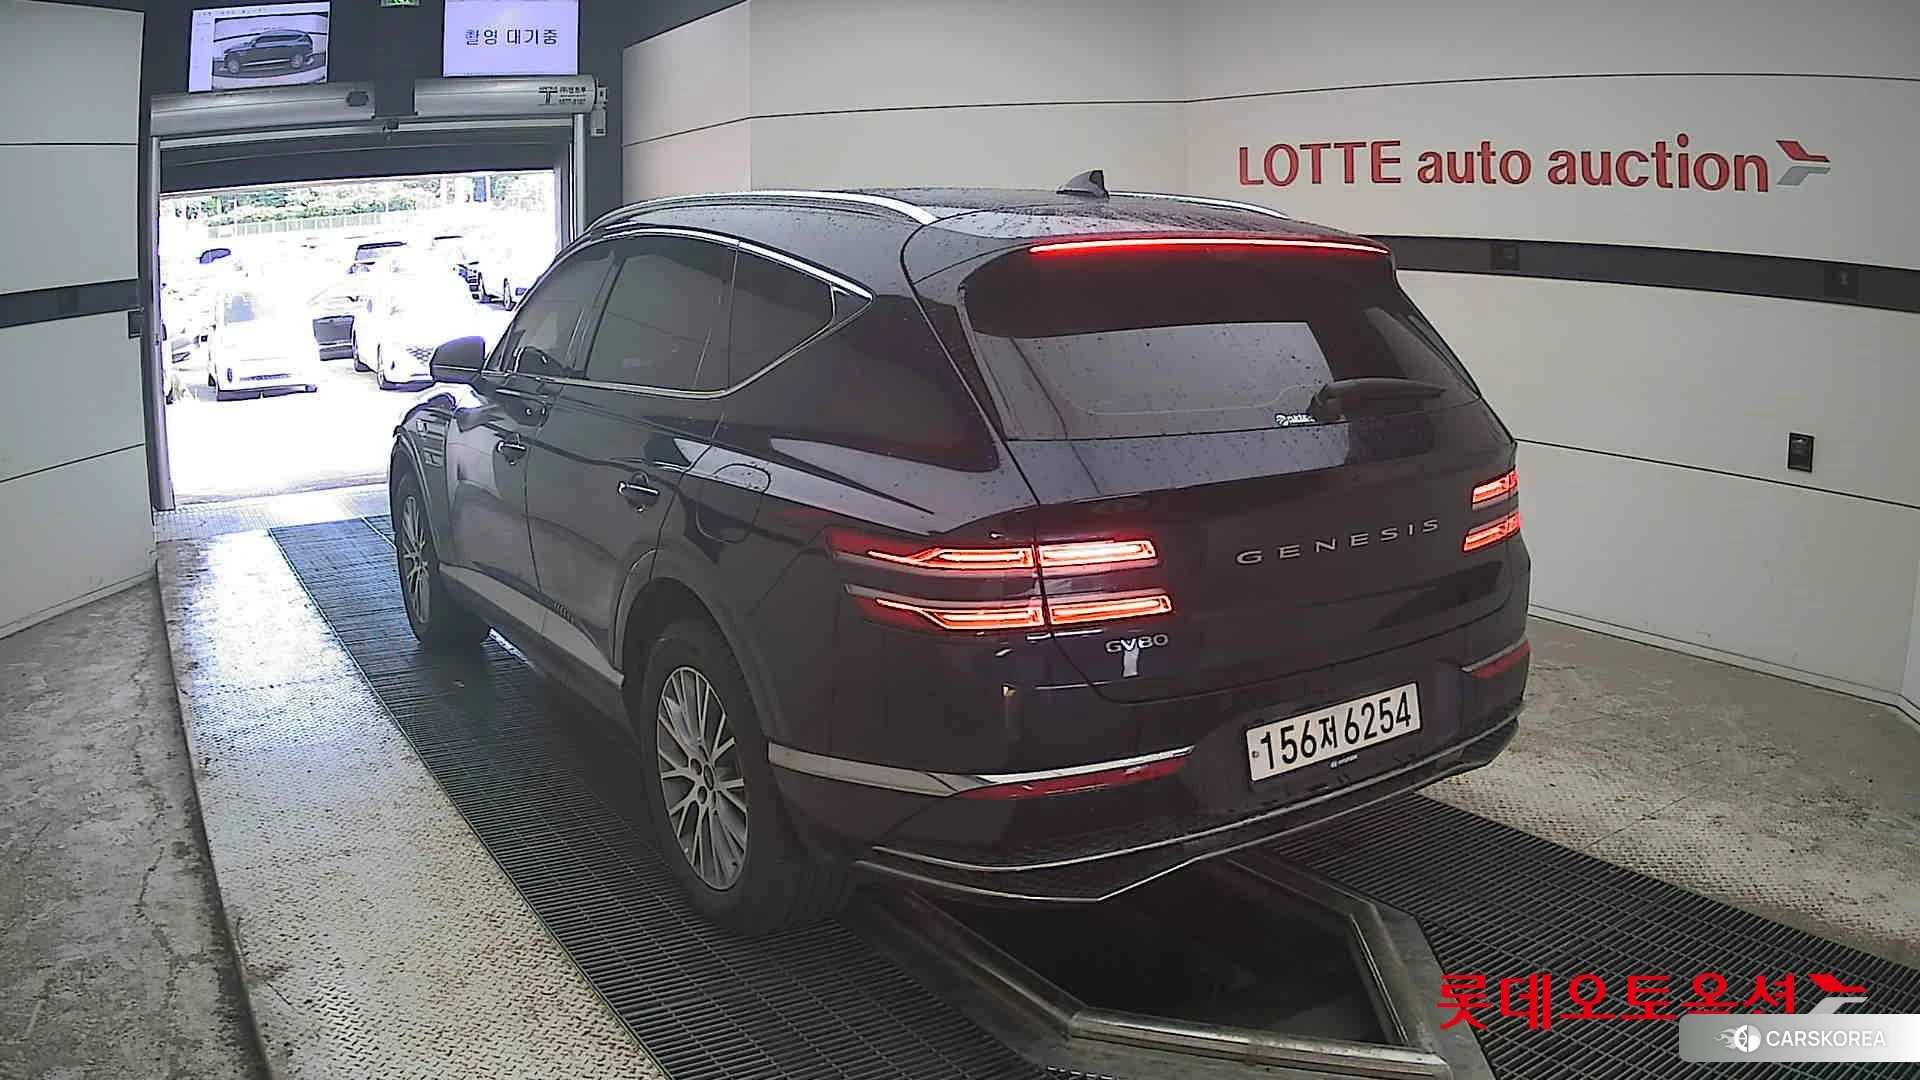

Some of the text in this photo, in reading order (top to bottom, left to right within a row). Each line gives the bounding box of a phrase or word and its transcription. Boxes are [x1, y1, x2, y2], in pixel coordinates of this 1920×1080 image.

[1238, 133, 1769, 192] LOTTE auto auction
[1236, 519, 1438, 564] GENESIS
[1105, 633, 1169, 653] GV80
